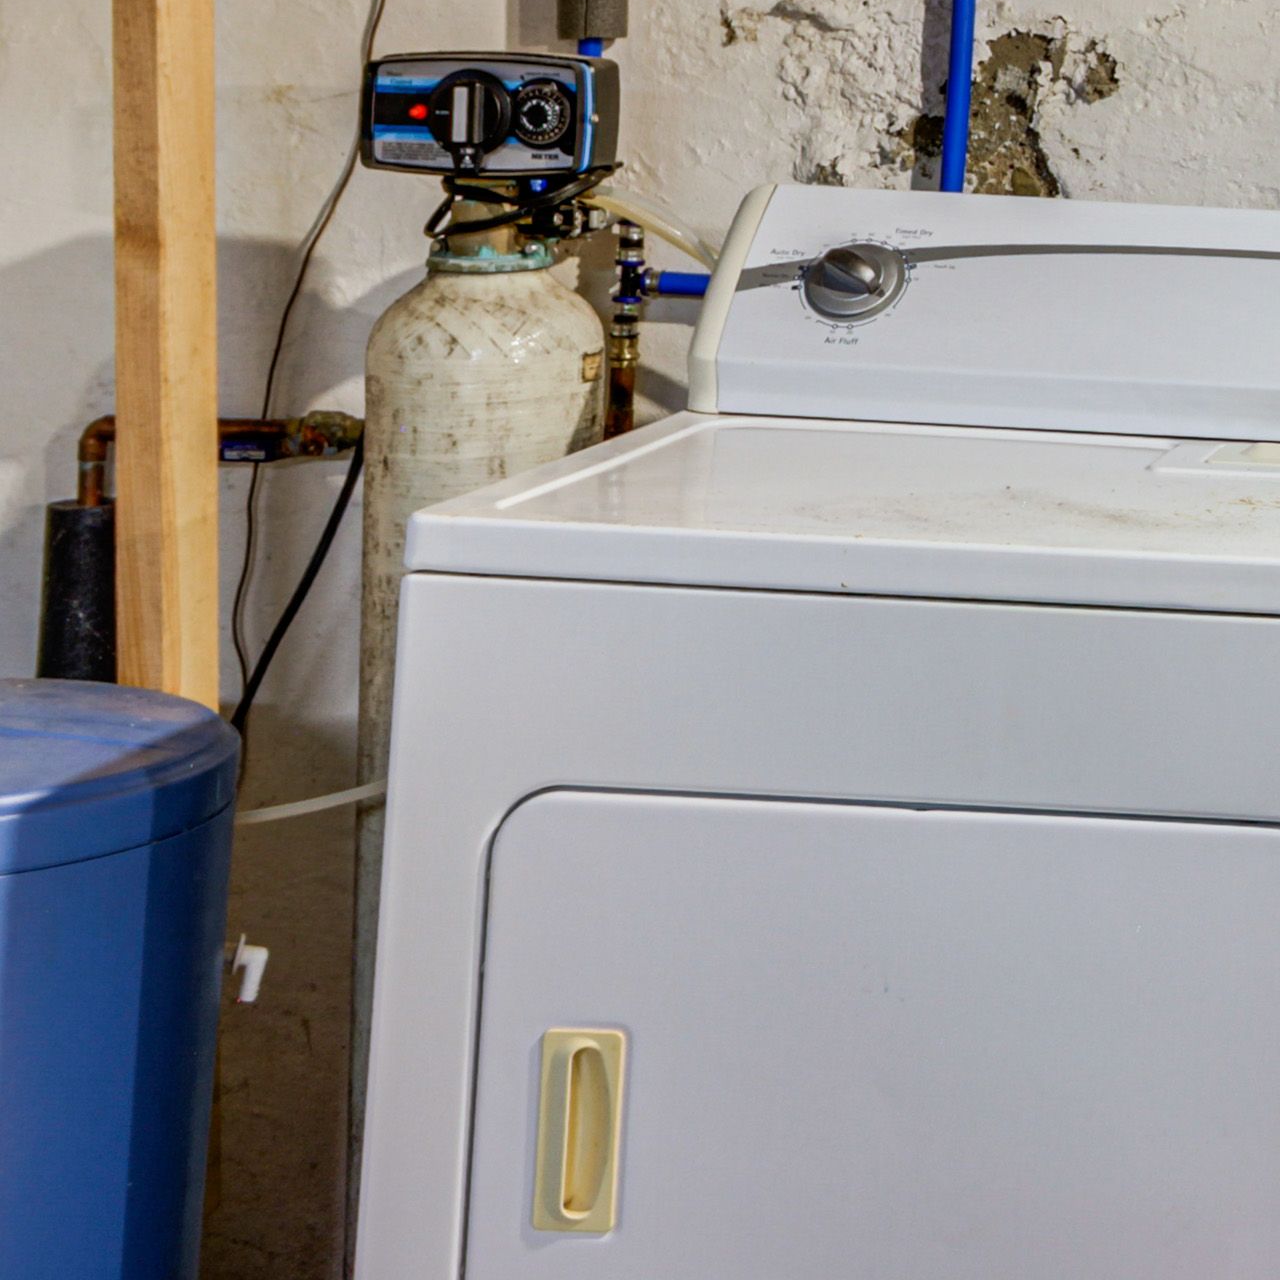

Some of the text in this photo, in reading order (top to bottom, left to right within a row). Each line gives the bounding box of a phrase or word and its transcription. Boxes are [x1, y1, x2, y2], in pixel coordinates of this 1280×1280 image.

[791, 249, 805, 257] Dry
[823, 337, 860, 346] Air Fluff
